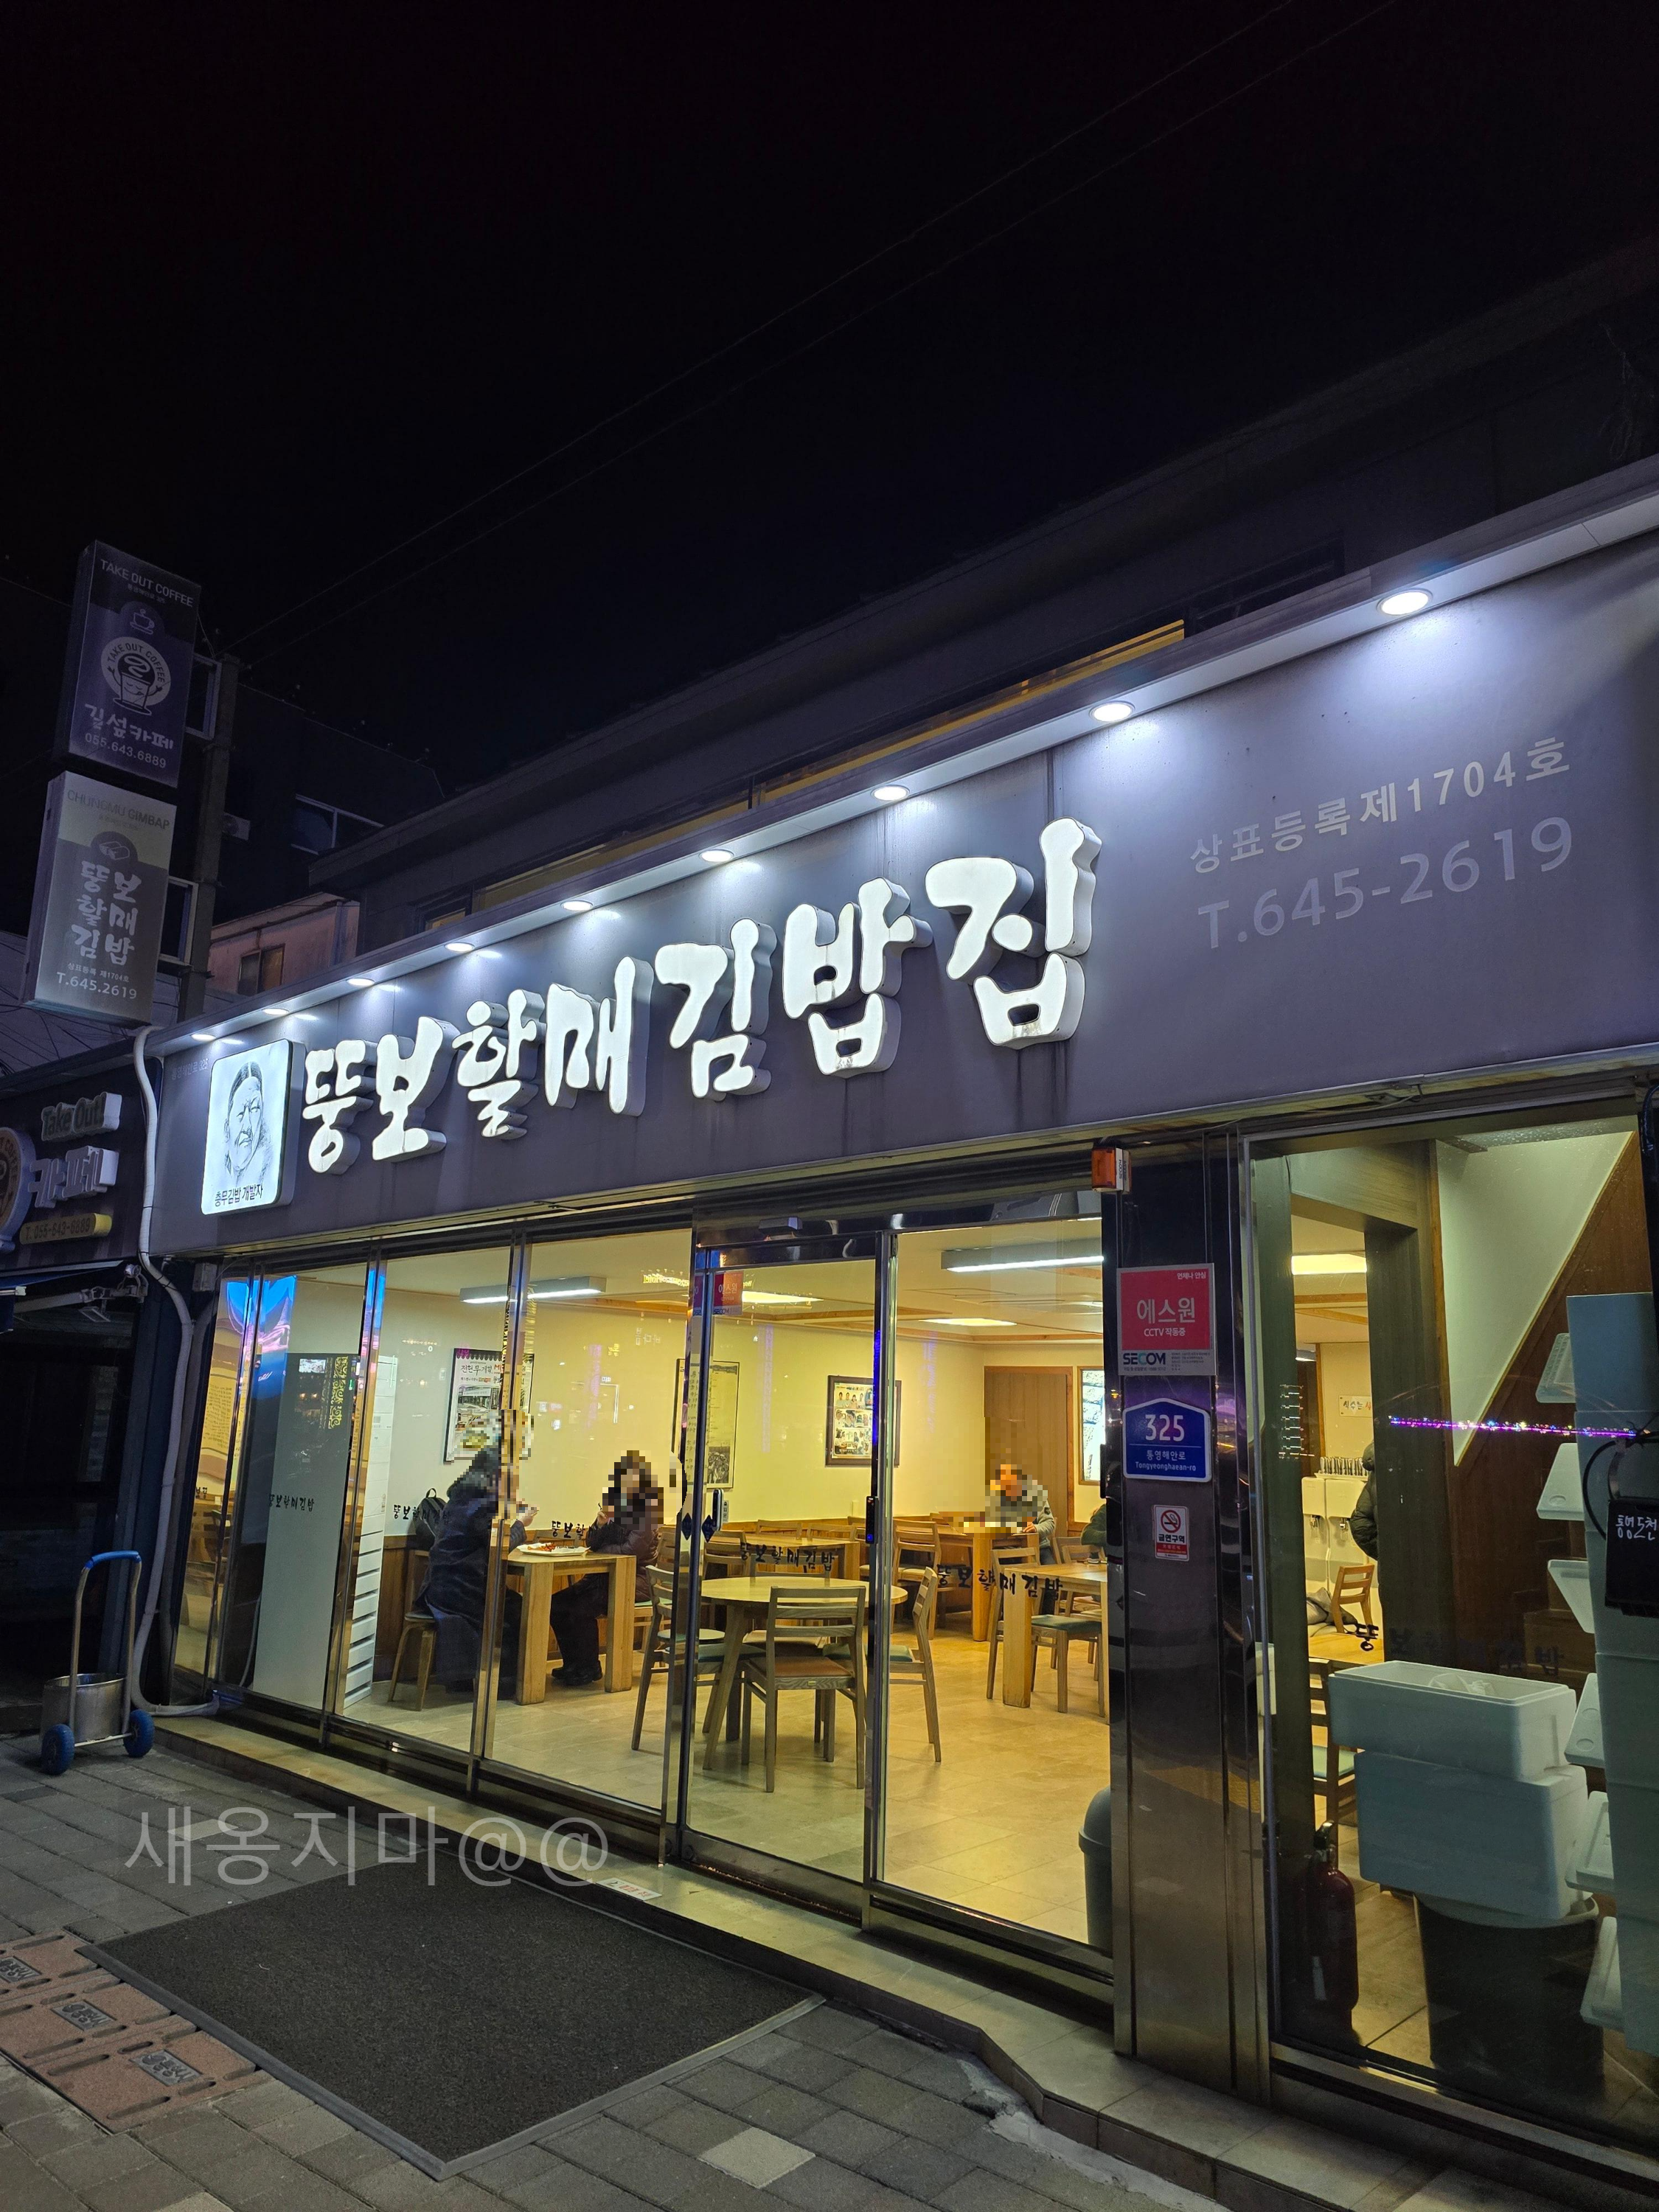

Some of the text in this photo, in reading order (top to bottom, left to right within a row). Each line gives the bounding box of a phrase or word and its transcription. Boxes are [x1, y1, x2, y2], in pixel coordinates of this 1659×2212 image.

[100, 558, 195, 608] TAKE OUT COFFEE
[107, 642, 166, 683] TAKE OUT COFFEE
[84, 732, 167, 769] 055.643.6889
[66, 789, 127, 818] CHUNGMU
[128, 807, 170, 830] GIMBAP
[80, 860, 142, 904] 뚱보
[1197, 815, 1573, 949] T.645-2619
[76, 897, 139, 936] 할매
[70, 924, 136, 967] 김밥
[67, 961, 97, 977] 상표등록
[56, 970, 138, 1000] T.645.2619
[43, 1109, 72, 1136] Take
[28, 1146, 105, 1208] 카페
[215, 1183, 264, 1207] 충무김밥 개발자
[1176, 1271, 1207, 1280] 언제나 안심
[1136, 1297, 1196, 1324] 에스원
[1144, 1327, 1186, 1338] CCTV 작동중
[1123, 1352, 1166, 1366] SECOM
[1144, 1413, 1185, 1442] 325
[1135, 1461, 1197, 1472] Tongyeonghaean-ro
[1146, 1449, 1186, 1461] 통영해안로
[1158, 1533, 1185, 1543] 금연구역
